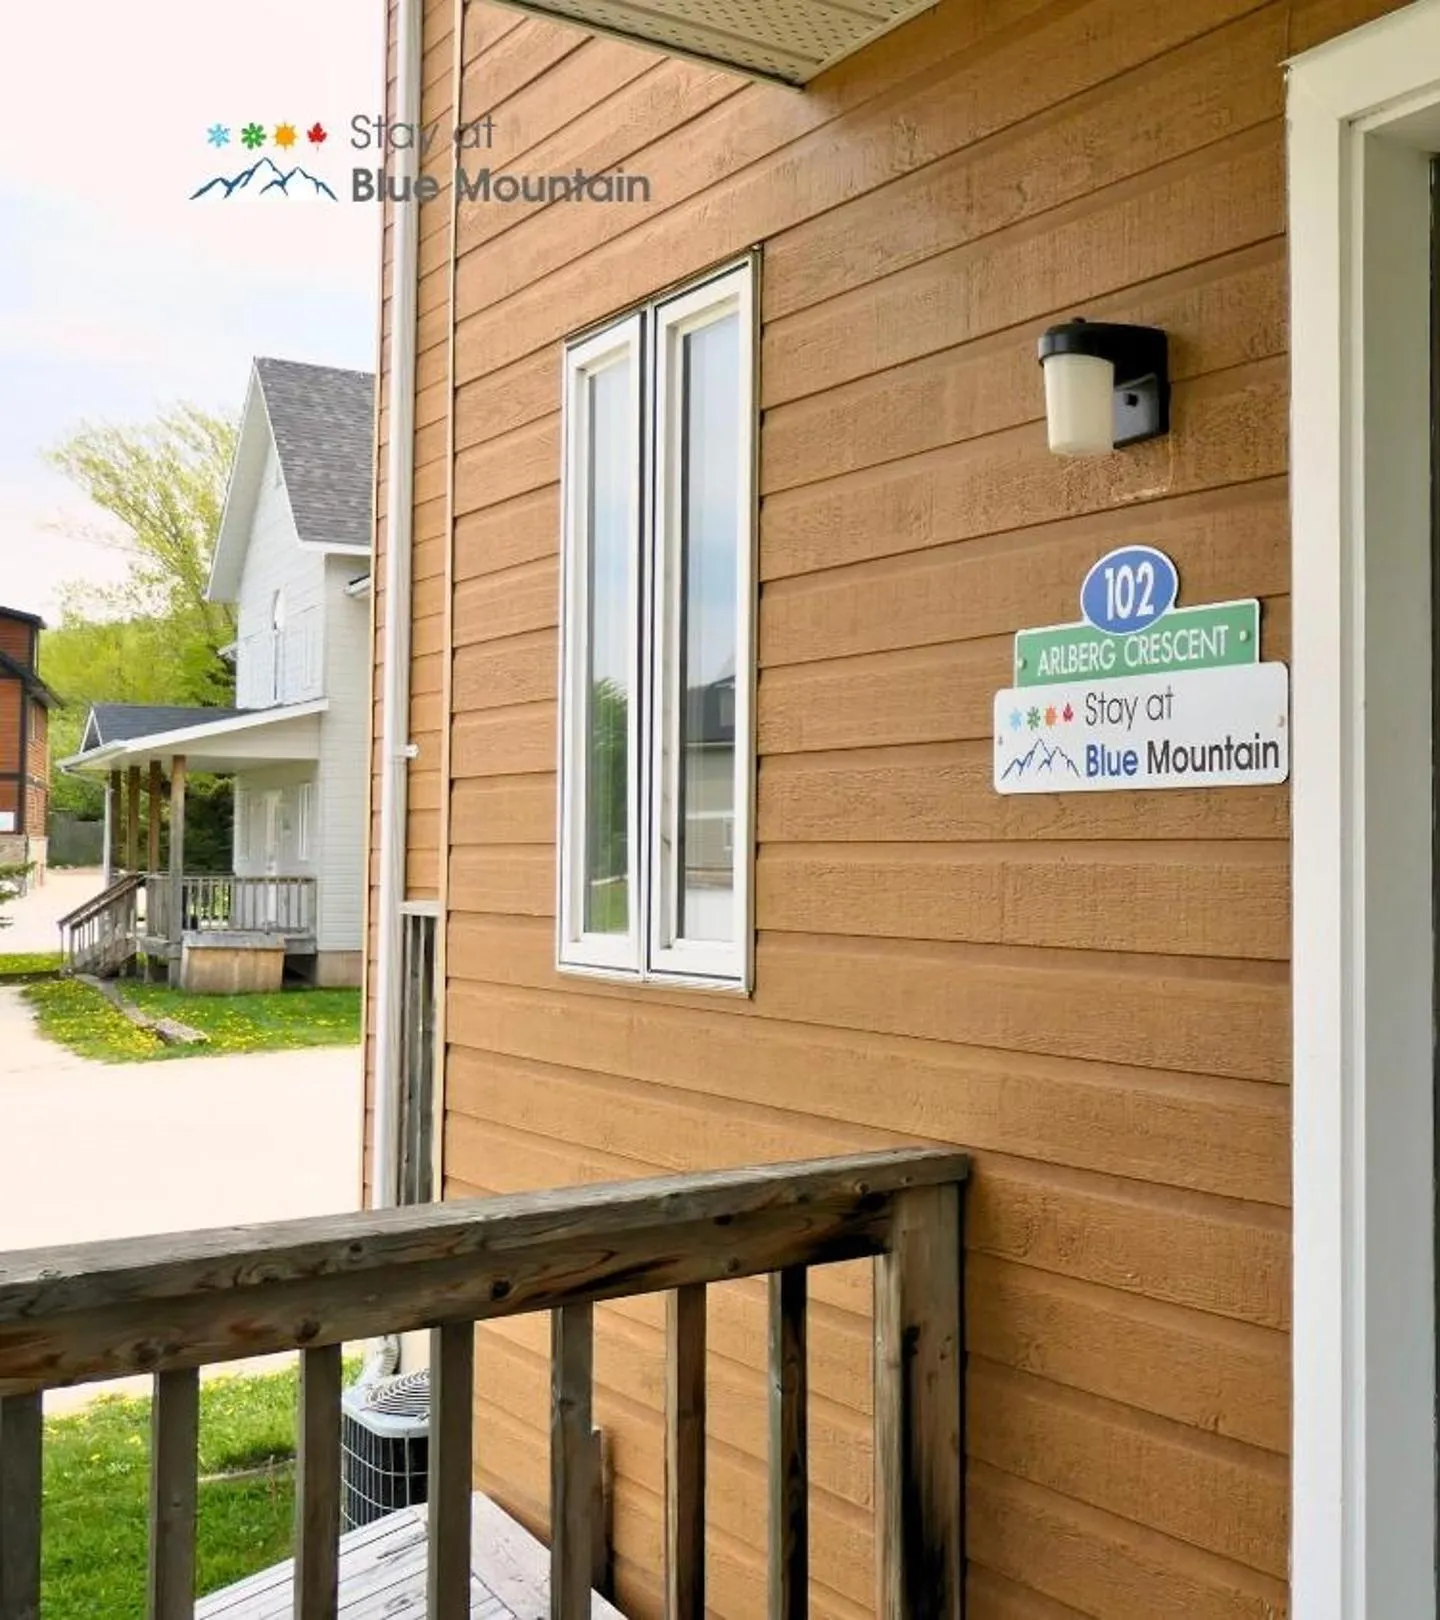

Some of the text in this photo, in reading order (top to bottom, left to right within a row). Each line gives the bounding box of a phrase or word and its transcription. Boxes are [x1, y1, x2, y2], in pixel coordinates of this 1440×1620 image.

[1104, 561, 1155, 621] 102
[1037, 625, 1229, 677] ARLBERG CRESCENT
[1085, 685, 1175, 731] Stay at
[1085, 733, 1280, 778] Blue Mountain
